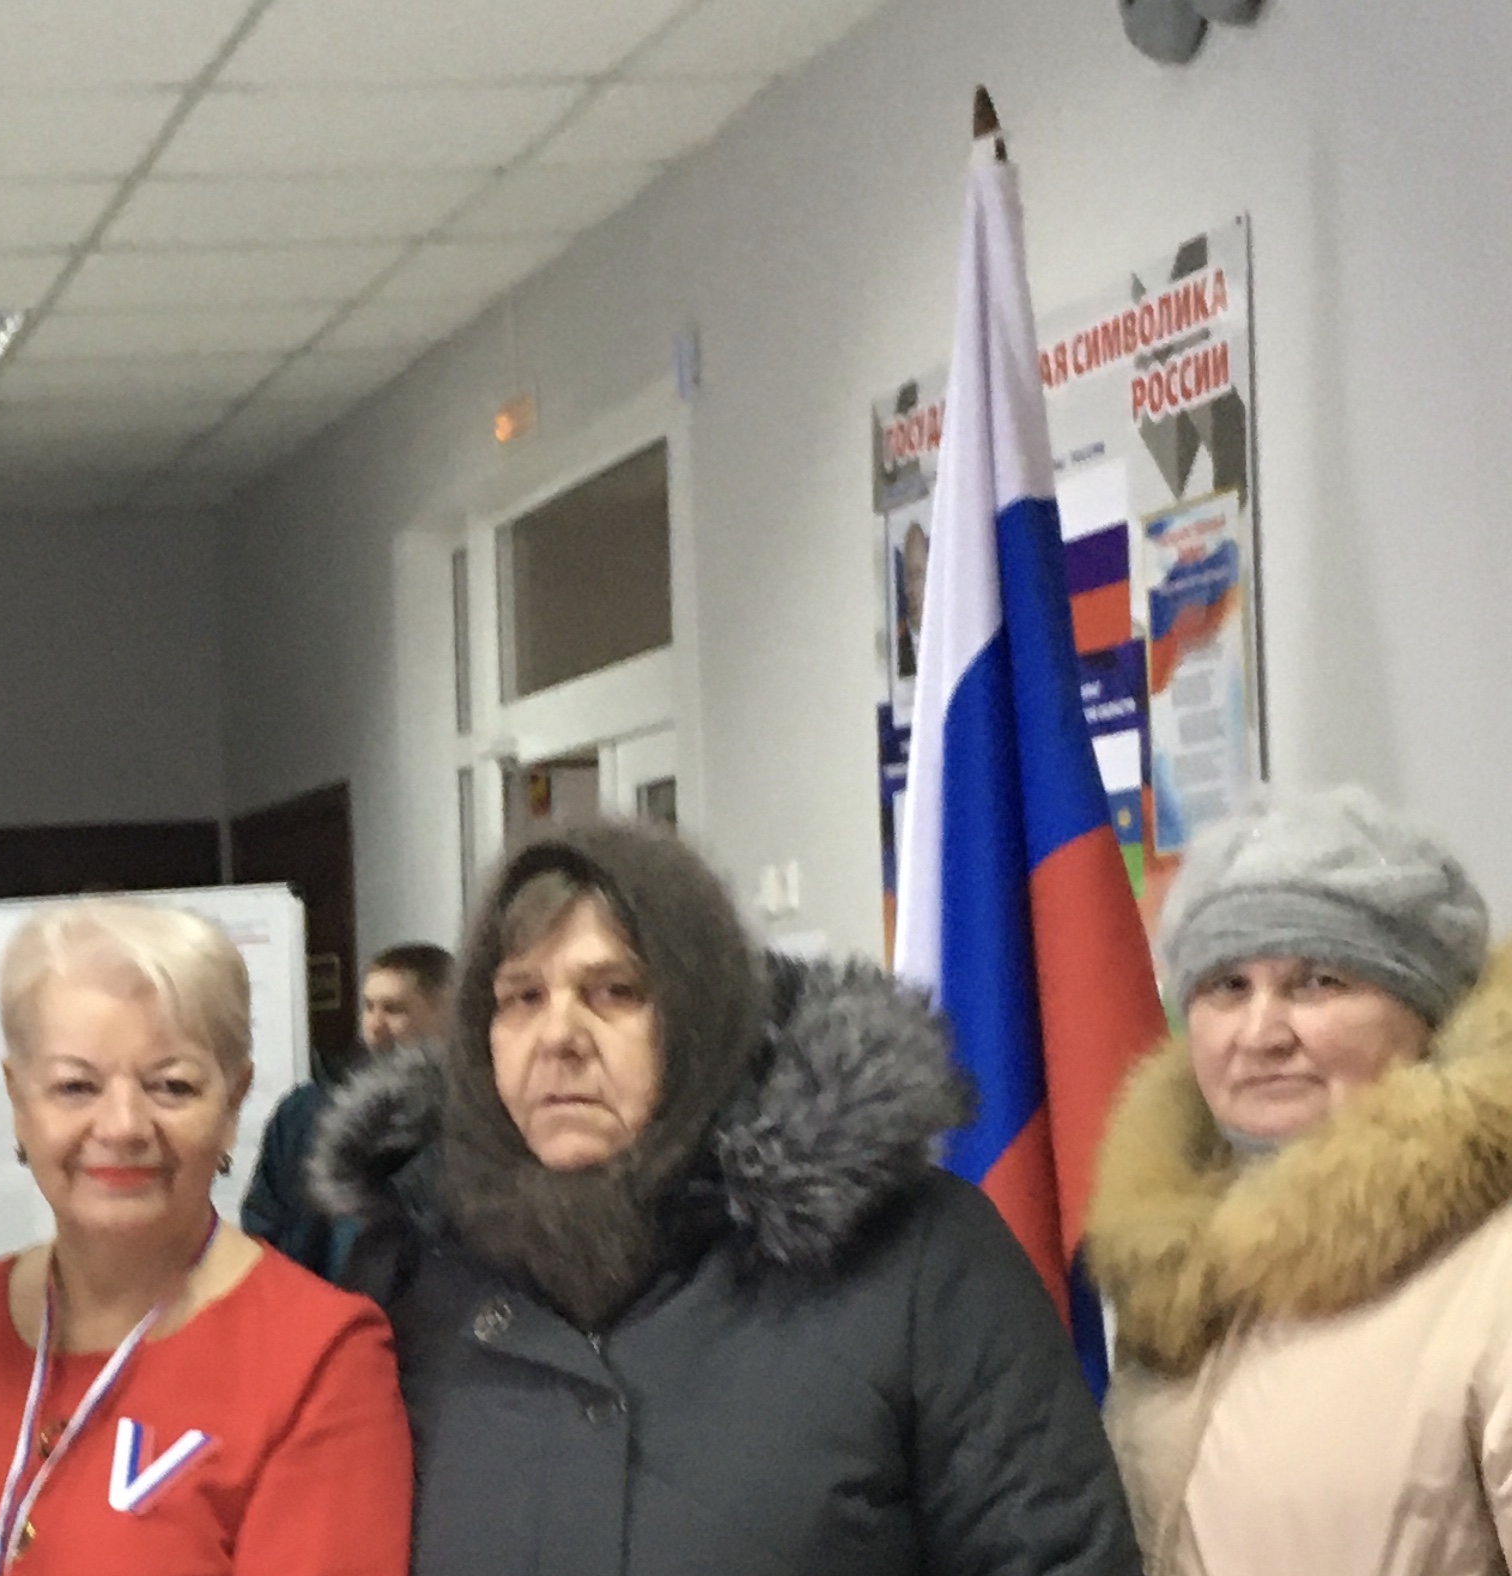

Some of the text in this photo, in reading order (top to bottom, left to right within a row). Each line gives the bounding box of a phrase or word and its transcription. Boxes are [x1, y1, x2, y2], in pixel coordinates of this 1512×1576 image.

[1040, 341, 1068, 389] АЯ
[1072, 267, 1228, 376] СИМВОЛИКА
[1131, 339, 1229, 423] РОССИИ
